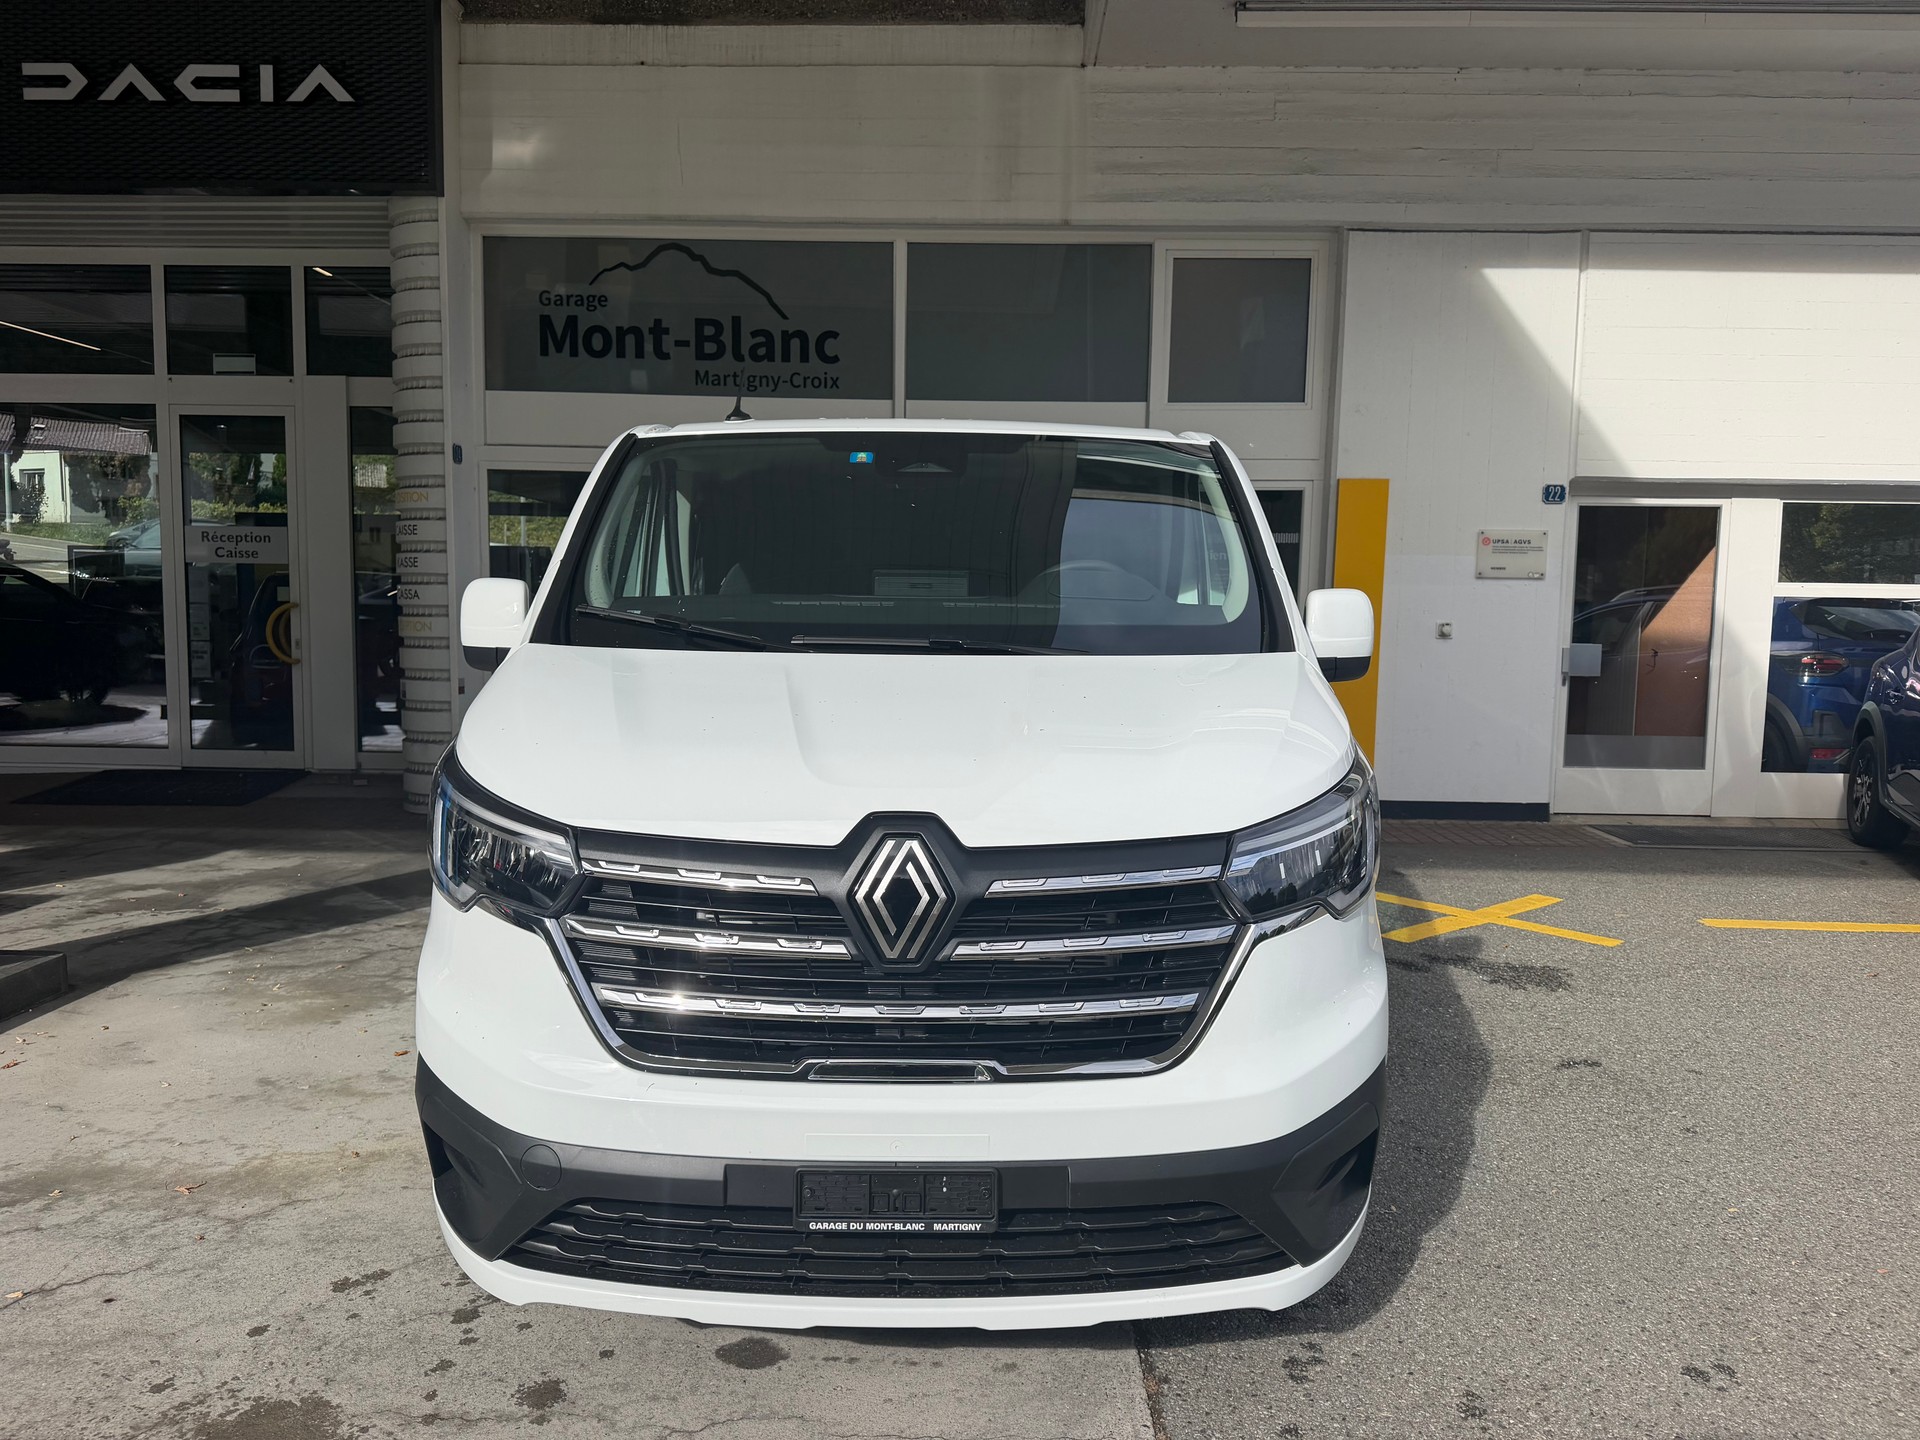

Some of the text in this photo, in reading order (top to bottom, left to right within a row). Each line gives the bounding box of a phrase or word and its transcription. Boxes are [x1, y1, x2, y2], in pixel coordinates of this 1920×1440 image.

[21, 62, 355, 102] DACIA
[539, 290, 608, 311] Garage
[539, 314, 840, 364] Mont-Blanc
[695, 370, 840, 392] Martgny-Croix
[1549, 487, 1561, 501] 22
[201, 531, 271, 546] Réception
[214, 547, 259, 559] Caisse
[809, 1222, 982, 1231] GARAGE DU MONT-BLANC MARTIGNY
